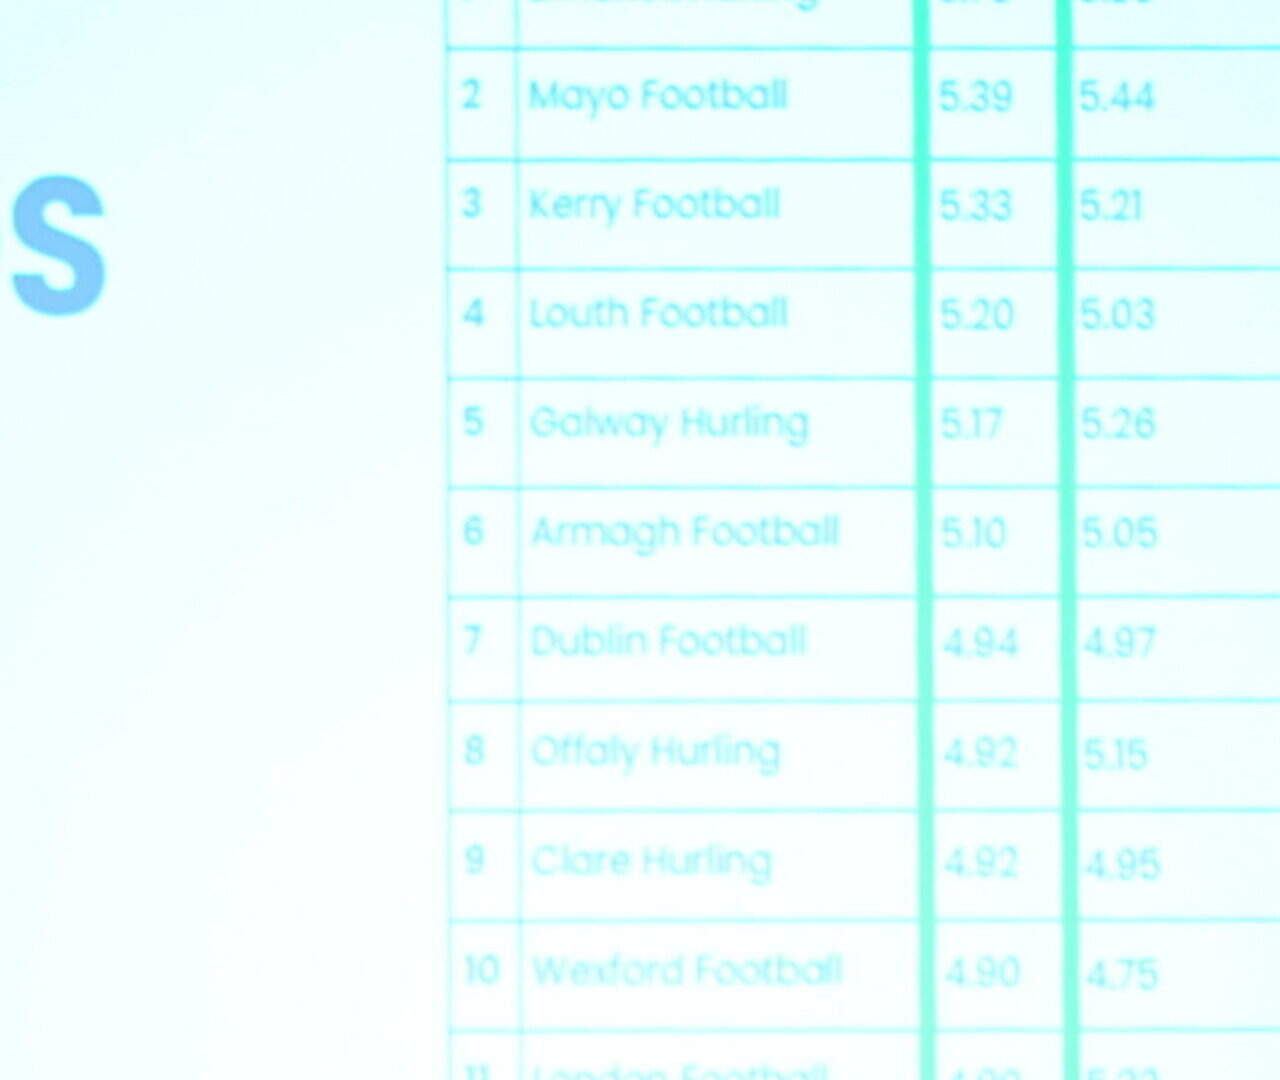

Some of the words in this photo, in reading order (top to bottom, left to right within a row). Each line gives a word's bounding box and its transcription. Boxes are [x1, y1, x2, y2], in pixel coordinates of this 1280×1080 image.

[462, 77, 481, 109] 2
[528, 80, 630, 120] Mayo
[641, 78, 788, 110] Football
[939, 79, 1013, 112] 5.39
[1079, 78, 1156, 112] 5.44
[462, 186, 483, 219] 3
[530, 190, 621, 227] Kerry
[634, 188, 780, 219] Football
[939, 188, 1012, 221] 5.33
[1080, 188, 1142, 222] 5.21
[463, 298, 485, 326] 4
[530, 297, 629, 328] Louth
[640, 296, 788, 328] Football
[941, 297, 1014, 331] 5.20
[1079, 296, 1156, 331] 5.03
[464, 405, 485, 437] 5
[529, 405, 668, 447] Galway
[682, 405, 810, 448] Hurling
[941, 405, 1004, 440] 5.17
[1081, 406, 1156, 440] 5.26
[463, 514, 484, 546] 6
[532, 516, 681, 557] Armagh
[692, 515, 840, 547] Football
[464, 623, 483, 654] 7
[531, 624, 648, 656] Dublin
[660, 624, 807, 656] Football
[464, 734, 485, 766] 8
[530, 734, 639, 776] Offaly
[651, 733, 781, 776] Hurling
[464, 843, 485, 875] 9
[531, 844, 632, 876] Clare
[642, 844, 773, 886] Hurling
[464, 953, 500, 984] 10
[532, 952, 684, 986] Wexford
[696, 952, 843, 986] Football
[1086, 957, 1159, 991] 4.75
